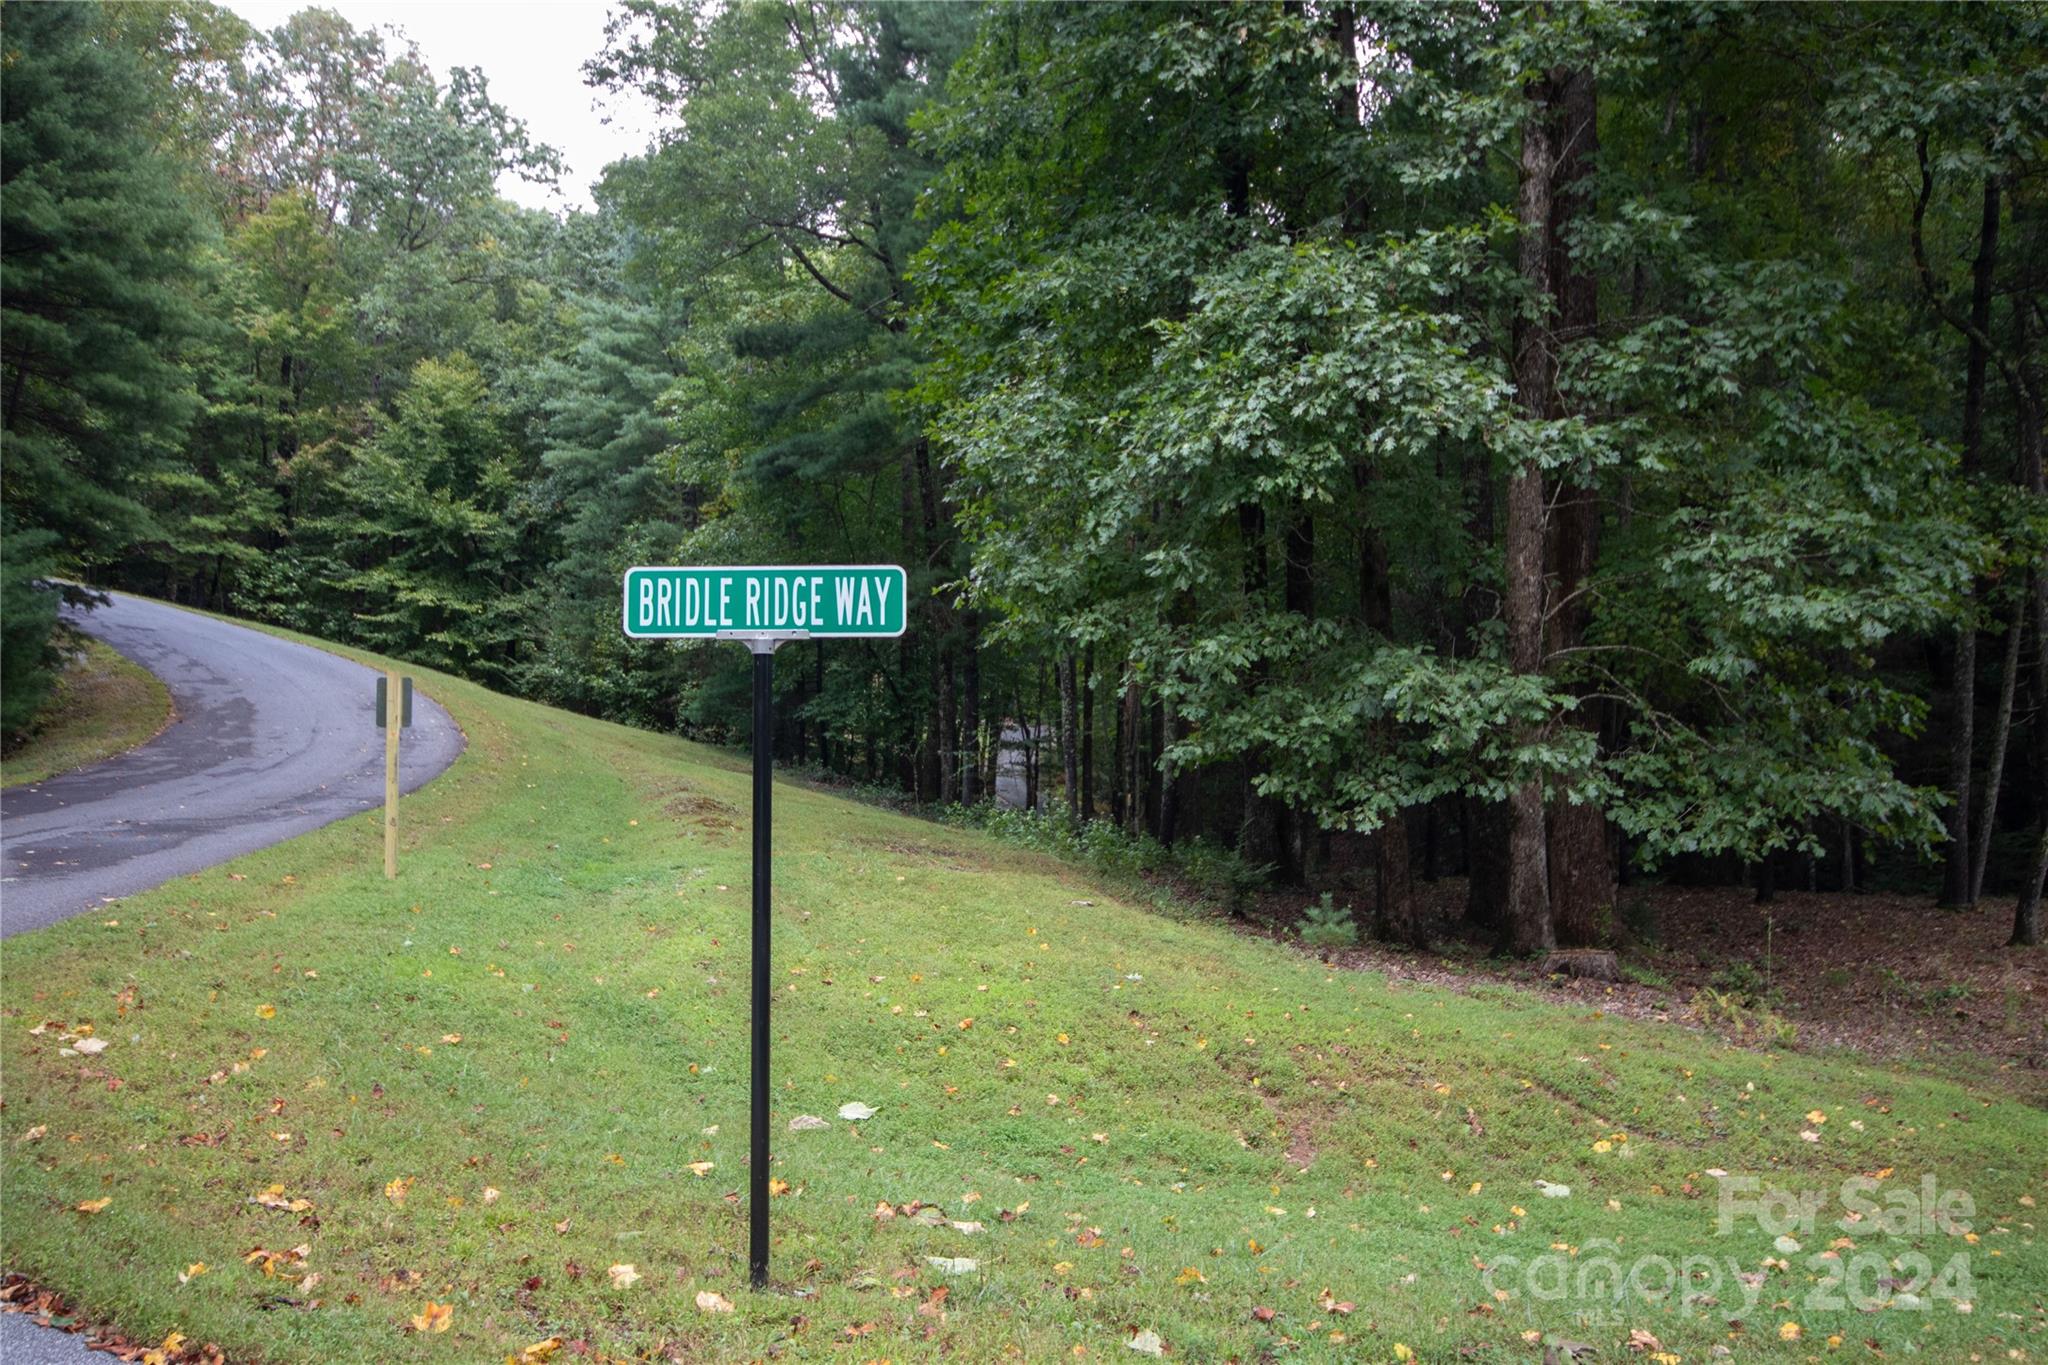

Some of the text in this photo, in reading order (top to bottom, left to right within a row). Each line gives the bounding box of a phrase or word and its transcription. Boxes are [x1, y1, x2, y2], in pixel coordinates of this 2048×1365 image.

[639, 576, 892, 627] BRIDLE RIDGE WAY
